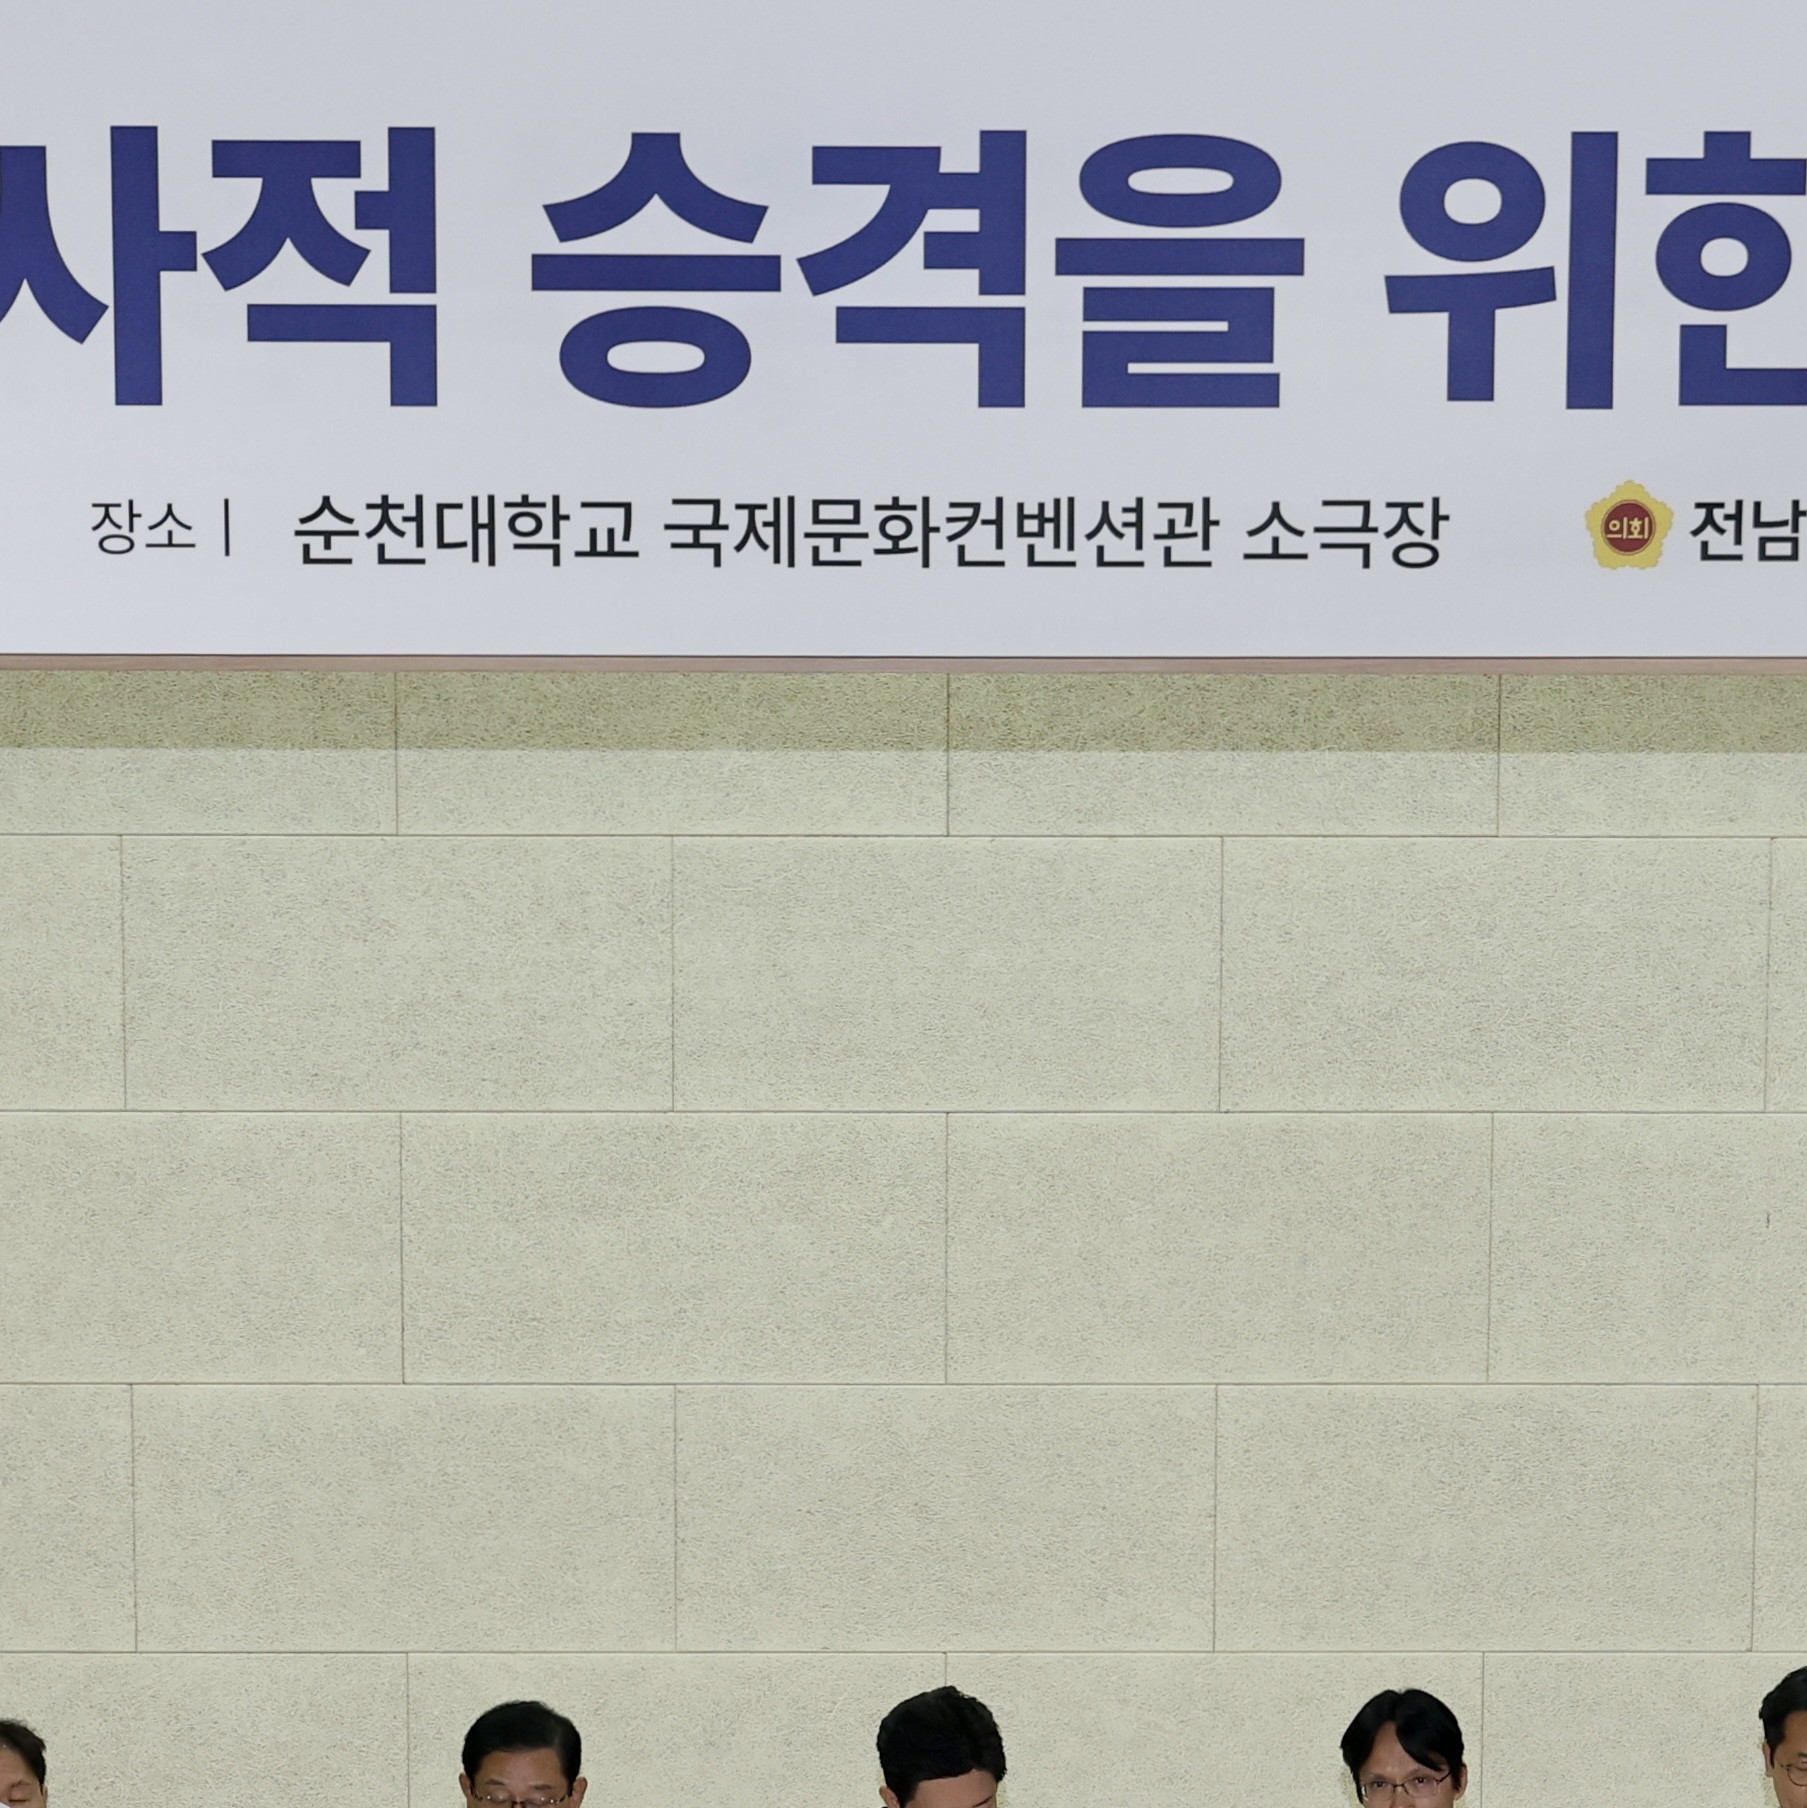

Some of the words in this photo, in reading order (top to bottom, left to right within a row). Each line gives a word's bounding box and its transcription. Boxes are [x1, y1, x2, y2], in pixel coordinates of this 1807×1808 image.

[531, 130, 1305, 408] 승격을
[92, 499, 196, 554] 장소
[294, 494, 639, 567] 순천대학교
[664, 496, 1220, 568] 국제문화컨벤션관
[1243, 497, 1450, 569] 소극장
[1606, 516, 1649, 540] 의회
